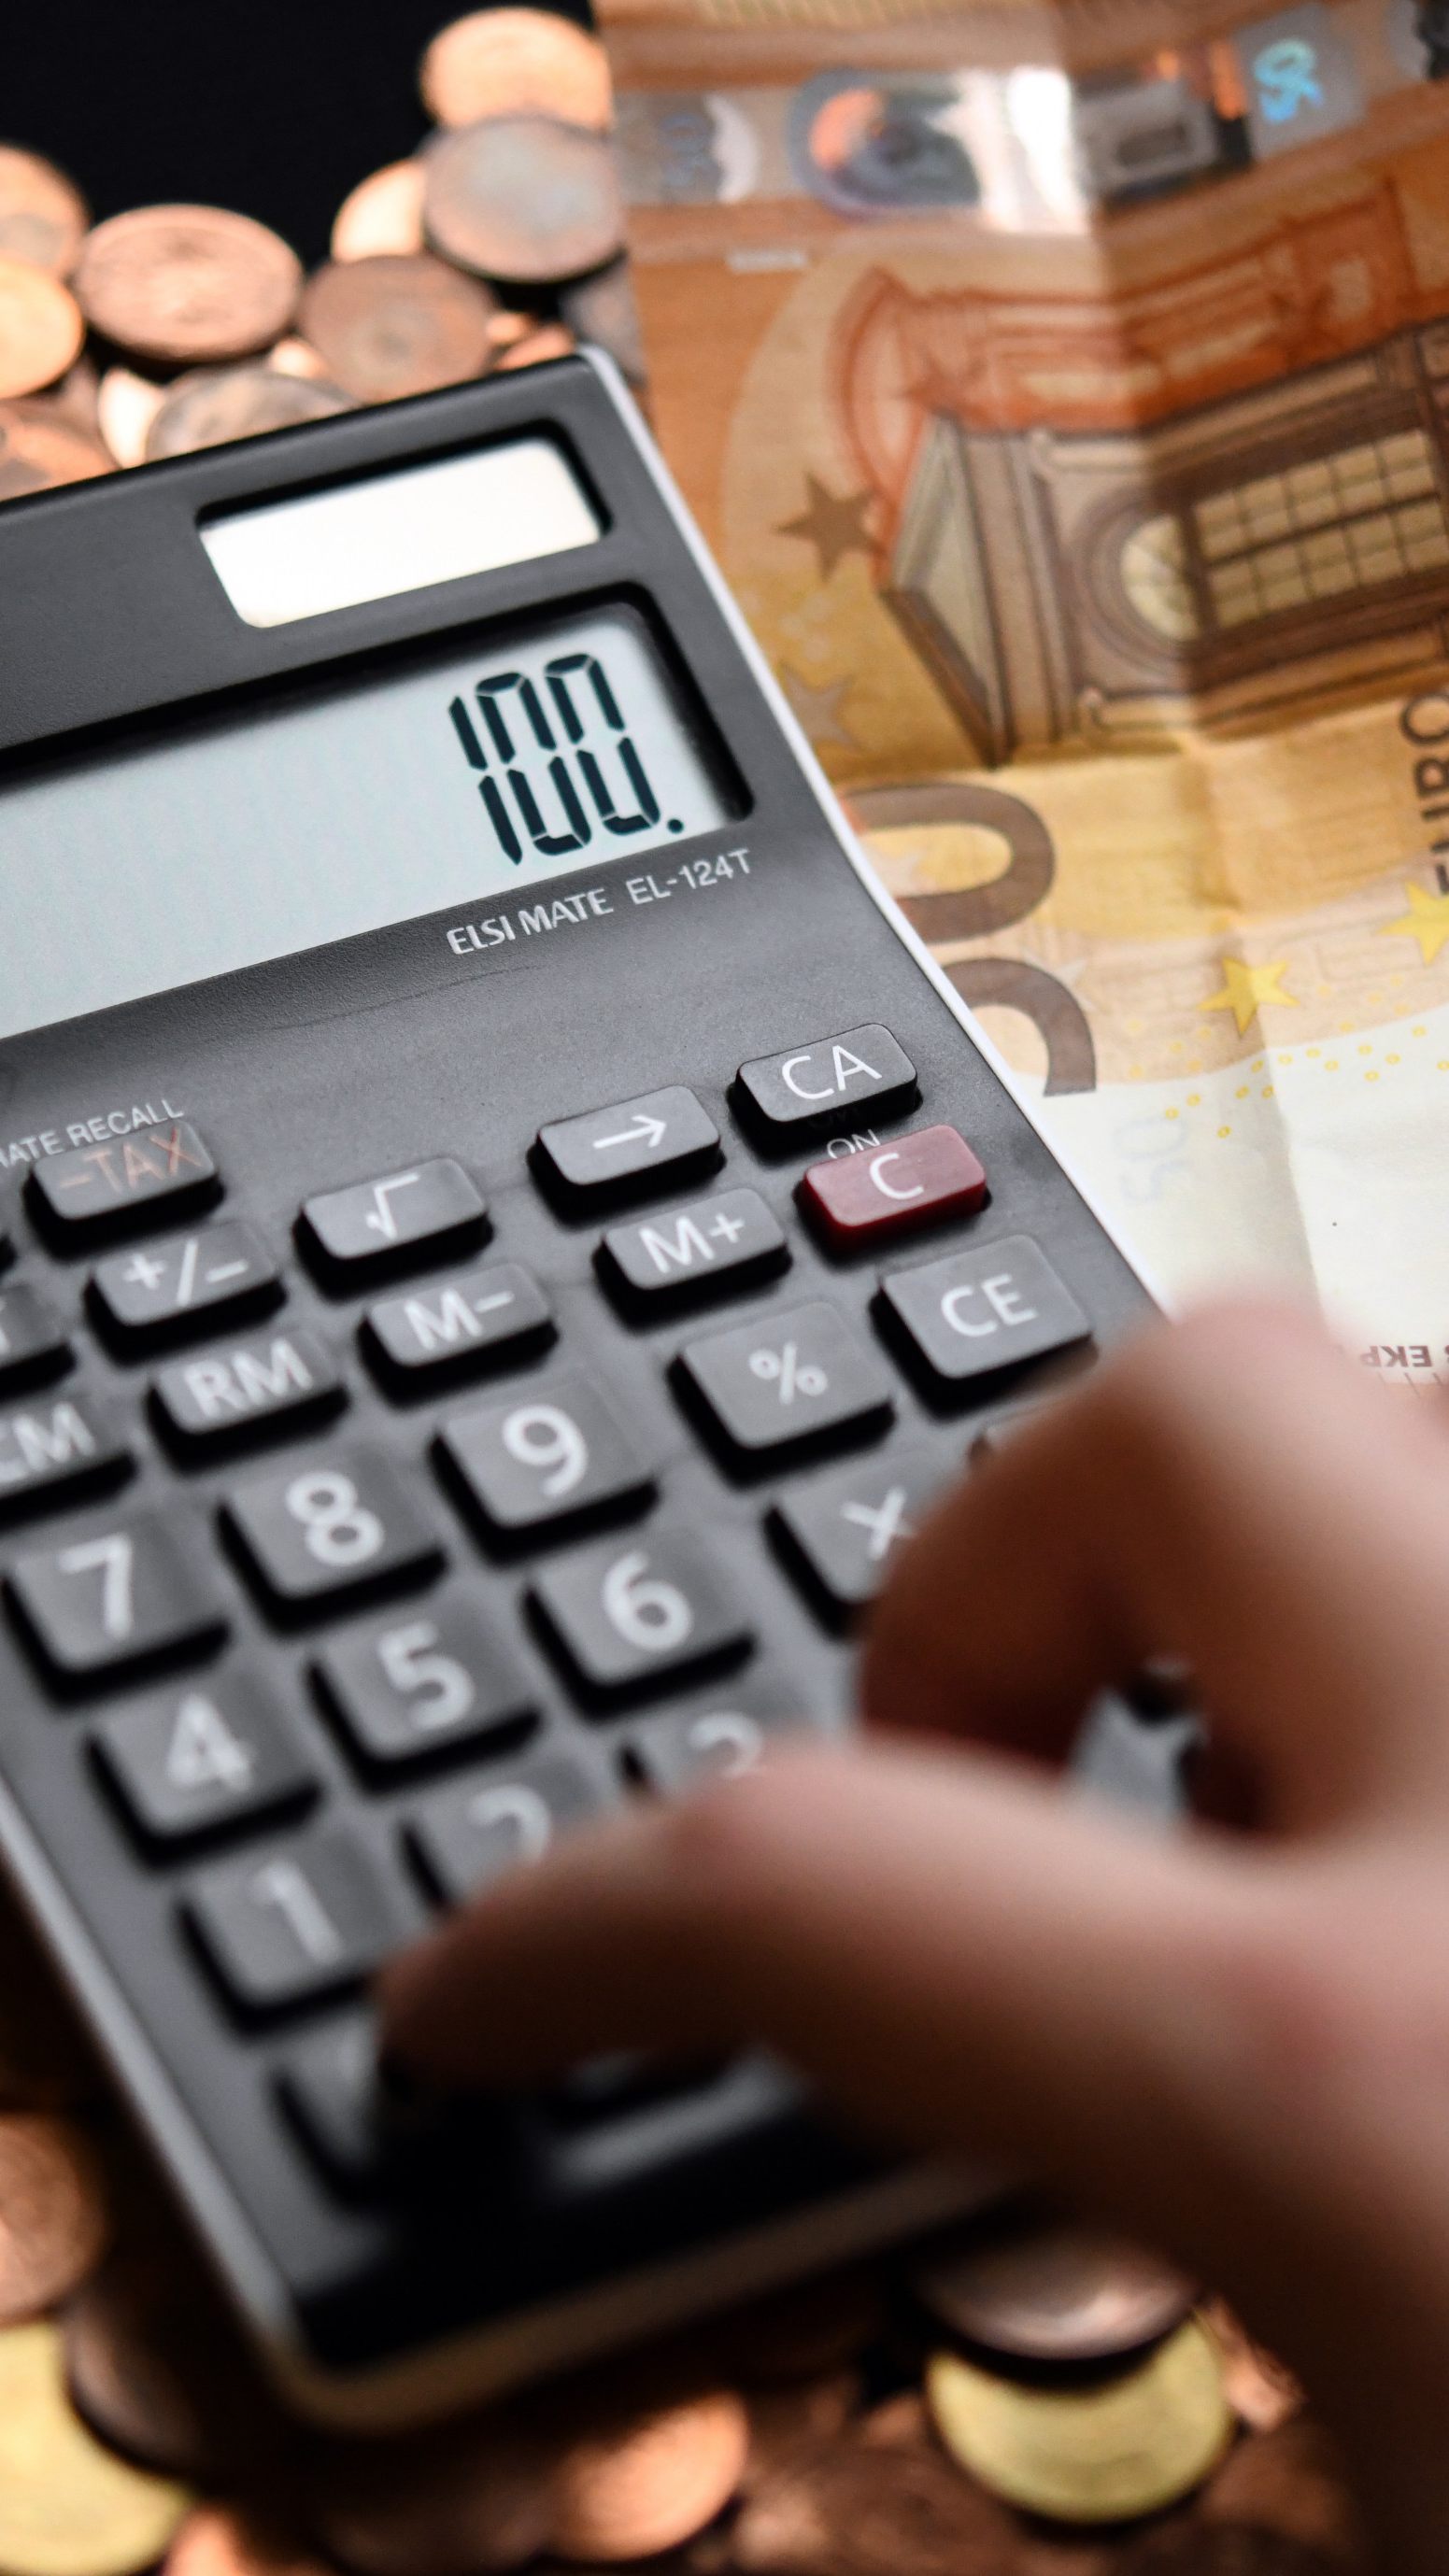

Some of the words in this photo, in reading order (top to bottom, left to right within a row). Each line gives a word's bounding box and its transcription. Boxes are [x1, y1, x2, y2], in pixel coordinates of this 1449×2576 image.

[447, 914, 516, 955] ELSI
[519, 887, 614, 935] MATE
[625, 848, 750, 905] EL-124T
[782, 1045, 883, 1100] CA
[65, 1097, 185, 1148] RECALL
[827, 1128, 880, 1159] ON
[869, 1153, 925, 1200] C
[638, 1212, 746, 1275] M+
[403, 1288, 515, 1351] M-
[940, 1272, 1038, 1338] CE
[184, 1338, 312, 1418] RM
[747, 1339, 829, 1406] %
[502, 1403, 590, 1498] 9
[285, 1469, 384, 1567] 8
[56, 1530, 134, 1640] 7
[603, 1550, 694, 1652] 6
[378, 1621, 476, 1732] 5
[165, 1691, 255, 1790] 4
[249, 1861, 344, 1967] 1
